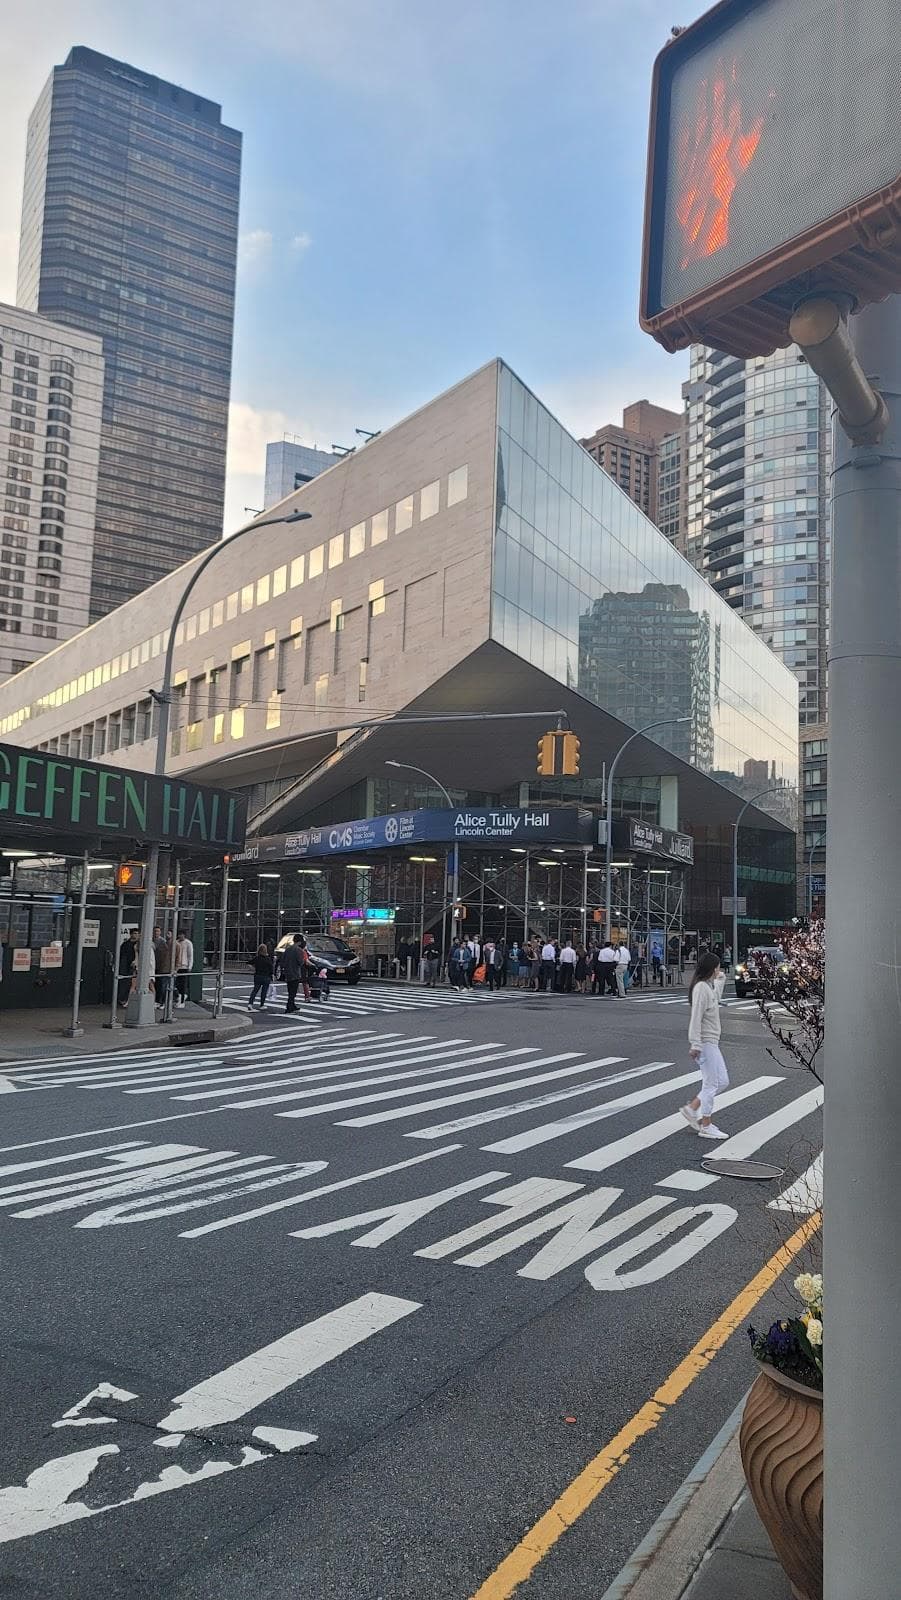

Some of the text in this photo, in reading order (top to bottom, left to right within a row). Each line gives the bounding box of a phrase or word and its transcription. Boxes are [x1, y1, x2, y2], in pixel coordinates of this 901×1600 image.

[163, 784, 241, 845] HALL
[454, 813, 550, 829] Alice Tully Hall
[310, 831, 322, 845] Hall
[329, 826, 353, 849] CMS
[455, 827, 514, 836] Lincoln Center
[633, 824, 663, 844] Alice Tully Hall
[287, 1170, 739, 1291] ONLY
